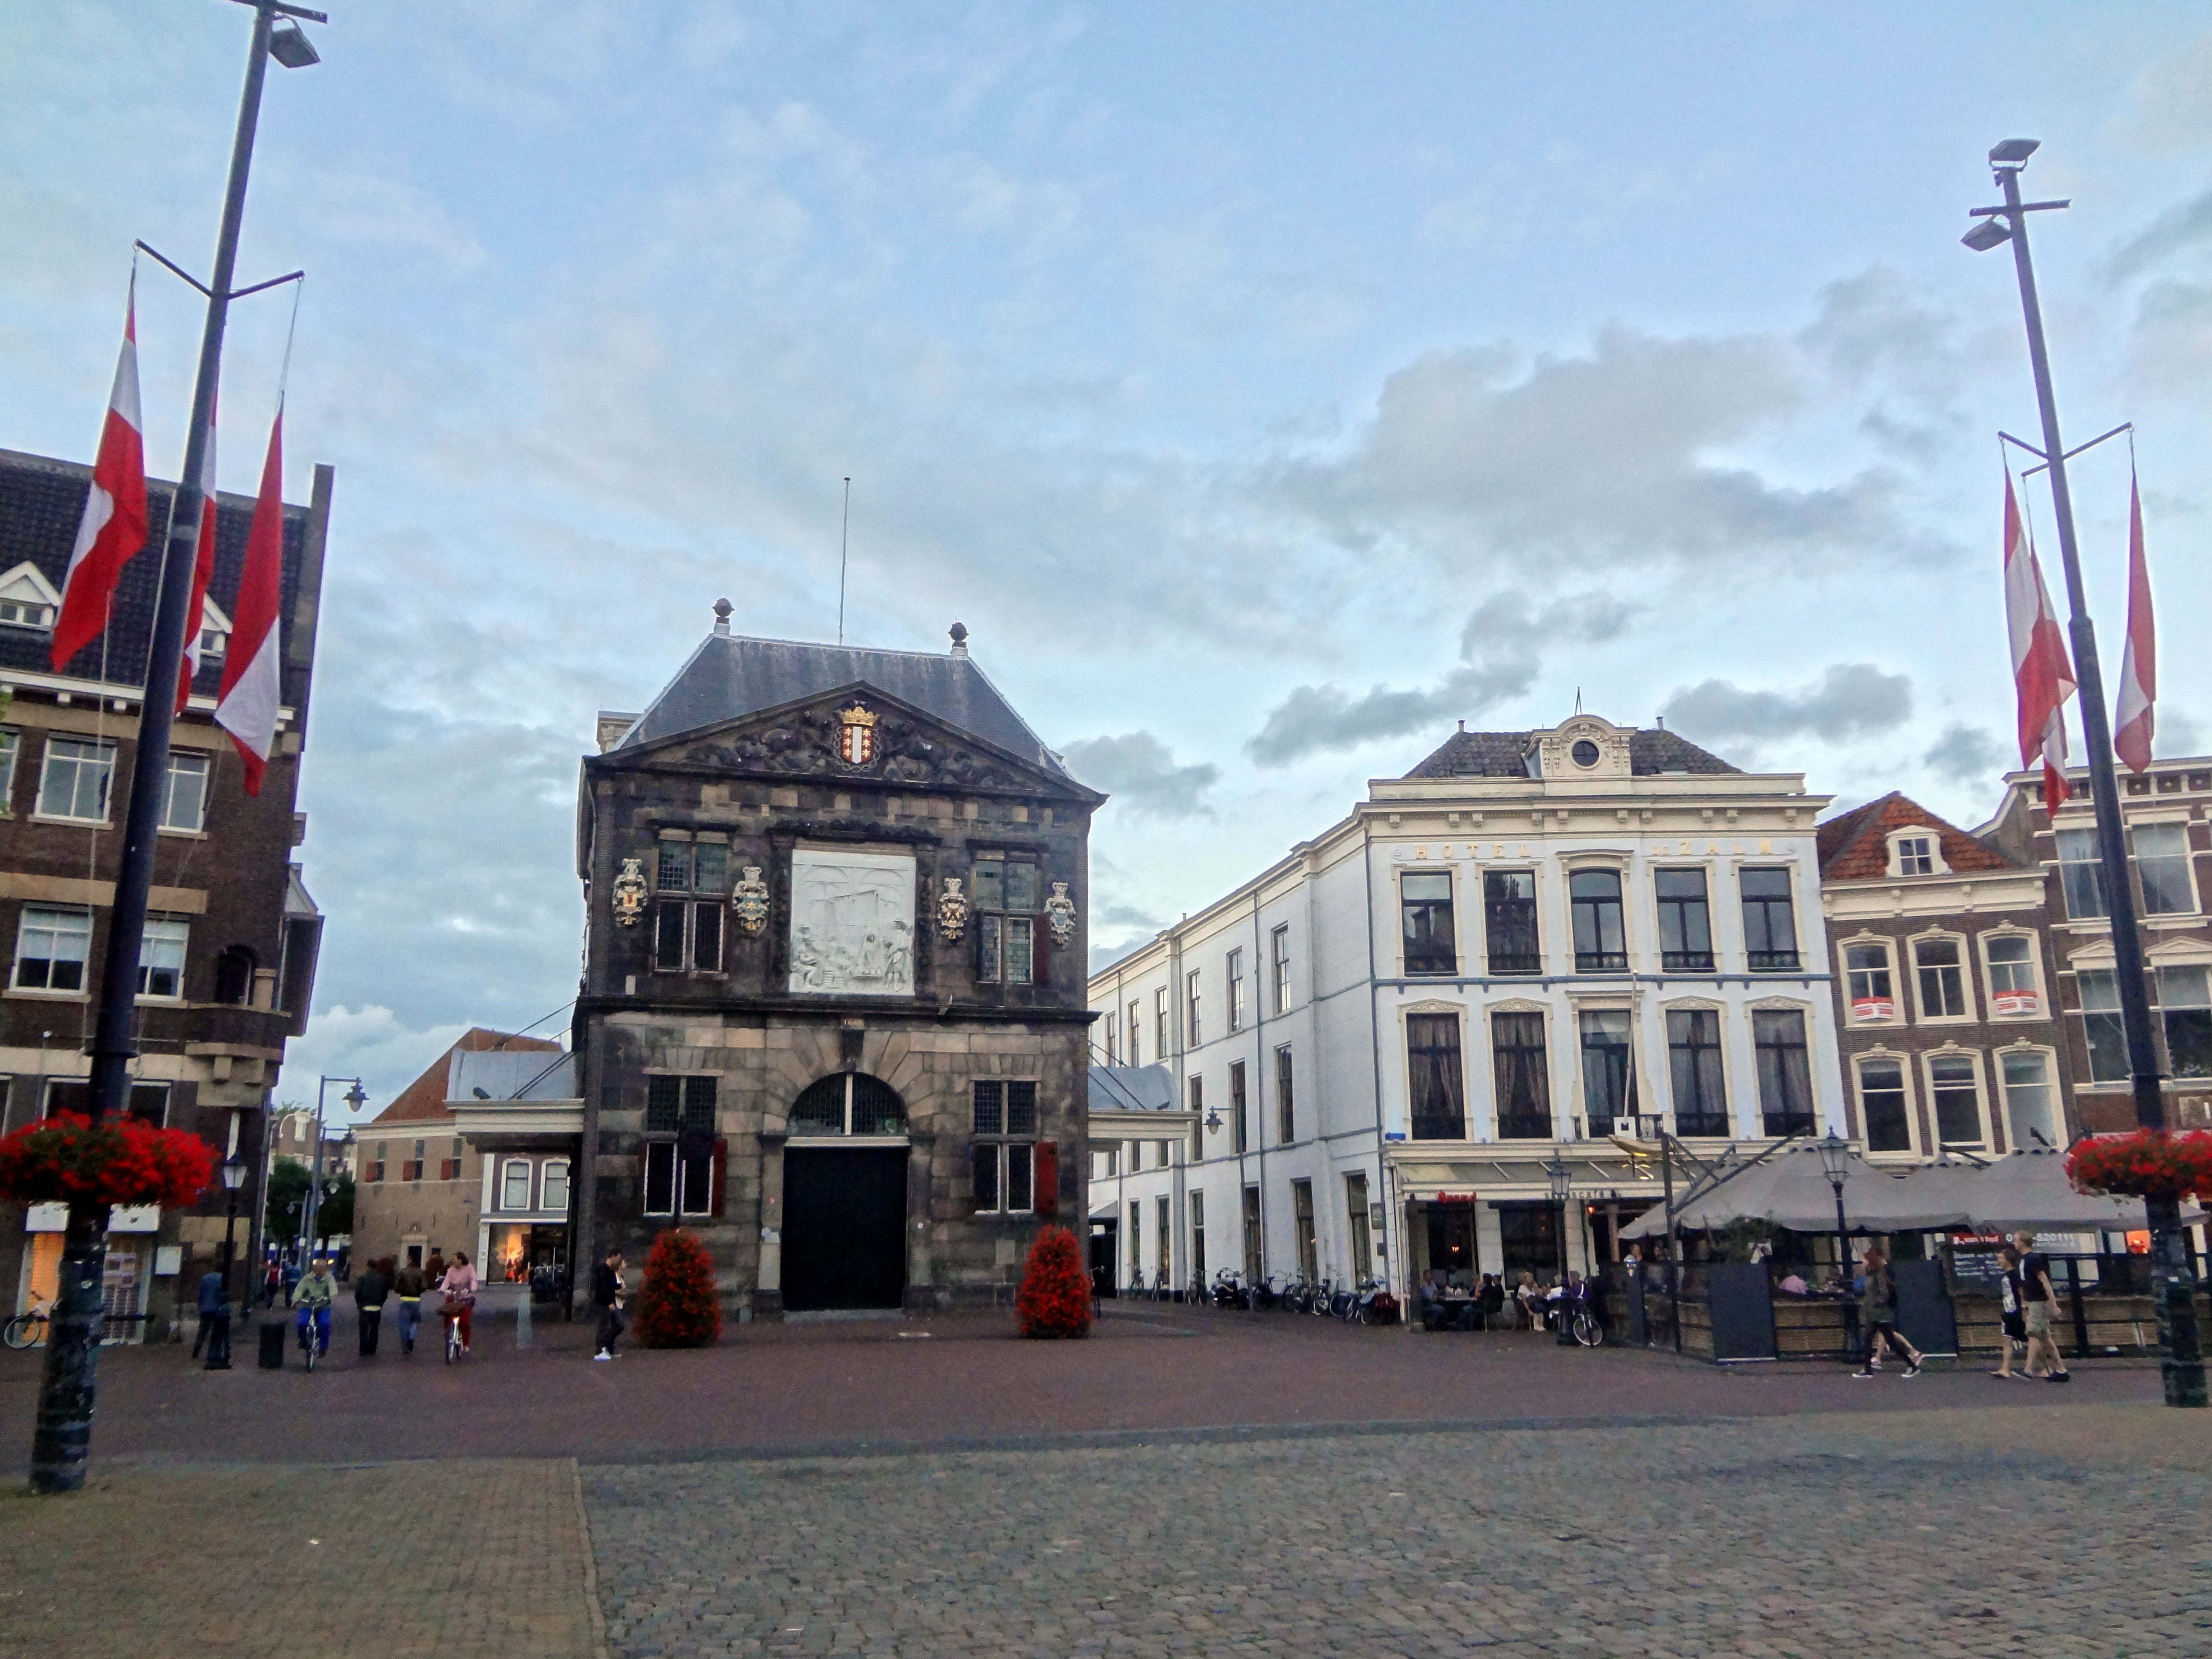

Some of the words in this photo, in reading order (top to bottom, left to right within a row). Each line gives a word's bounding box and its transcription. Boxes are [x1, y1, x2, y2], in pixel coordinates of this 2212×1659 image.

[1416, 844, 1531, 859] HOTEL
[1680, 841, 1772, 855] ZALM
[2005, 1233, 2074, 1242] 0-520111
